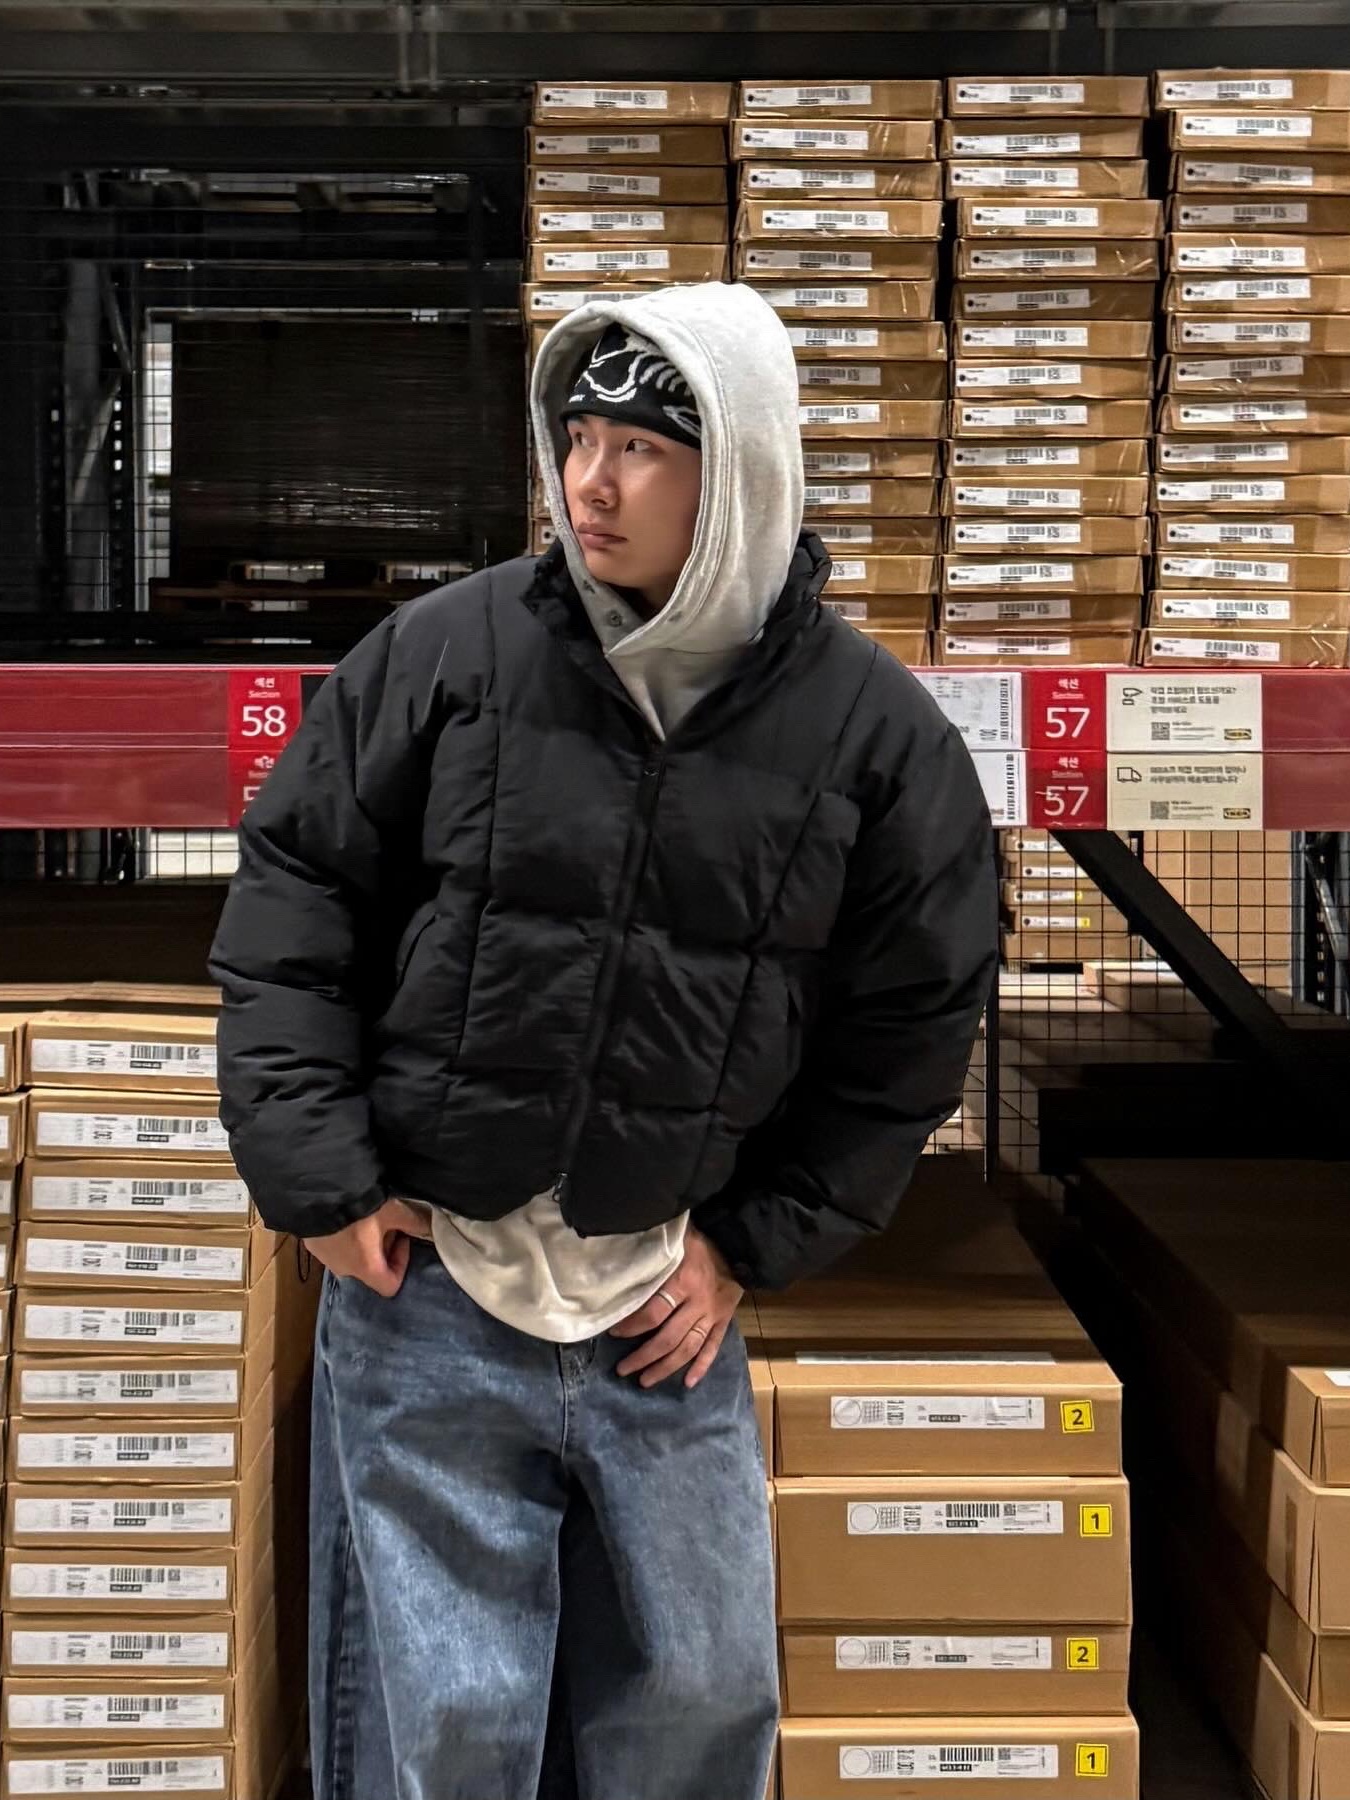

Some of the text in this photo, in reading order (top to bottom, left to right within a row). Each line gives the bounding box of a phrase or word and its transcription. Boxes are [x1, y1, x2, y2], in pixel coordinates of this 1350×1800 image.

[241, 705, 287, 737] 58
[1045, 707, 1090, 738] 57
[1043, 785, 1089, 816] 57
[1071, 1408, 1084, 1426] 2
[1090, 1513, 1100, 1530] 1
[1076, 1646, 1089, 1663] 2
[1086, 1752, 1096, 1769] 1
